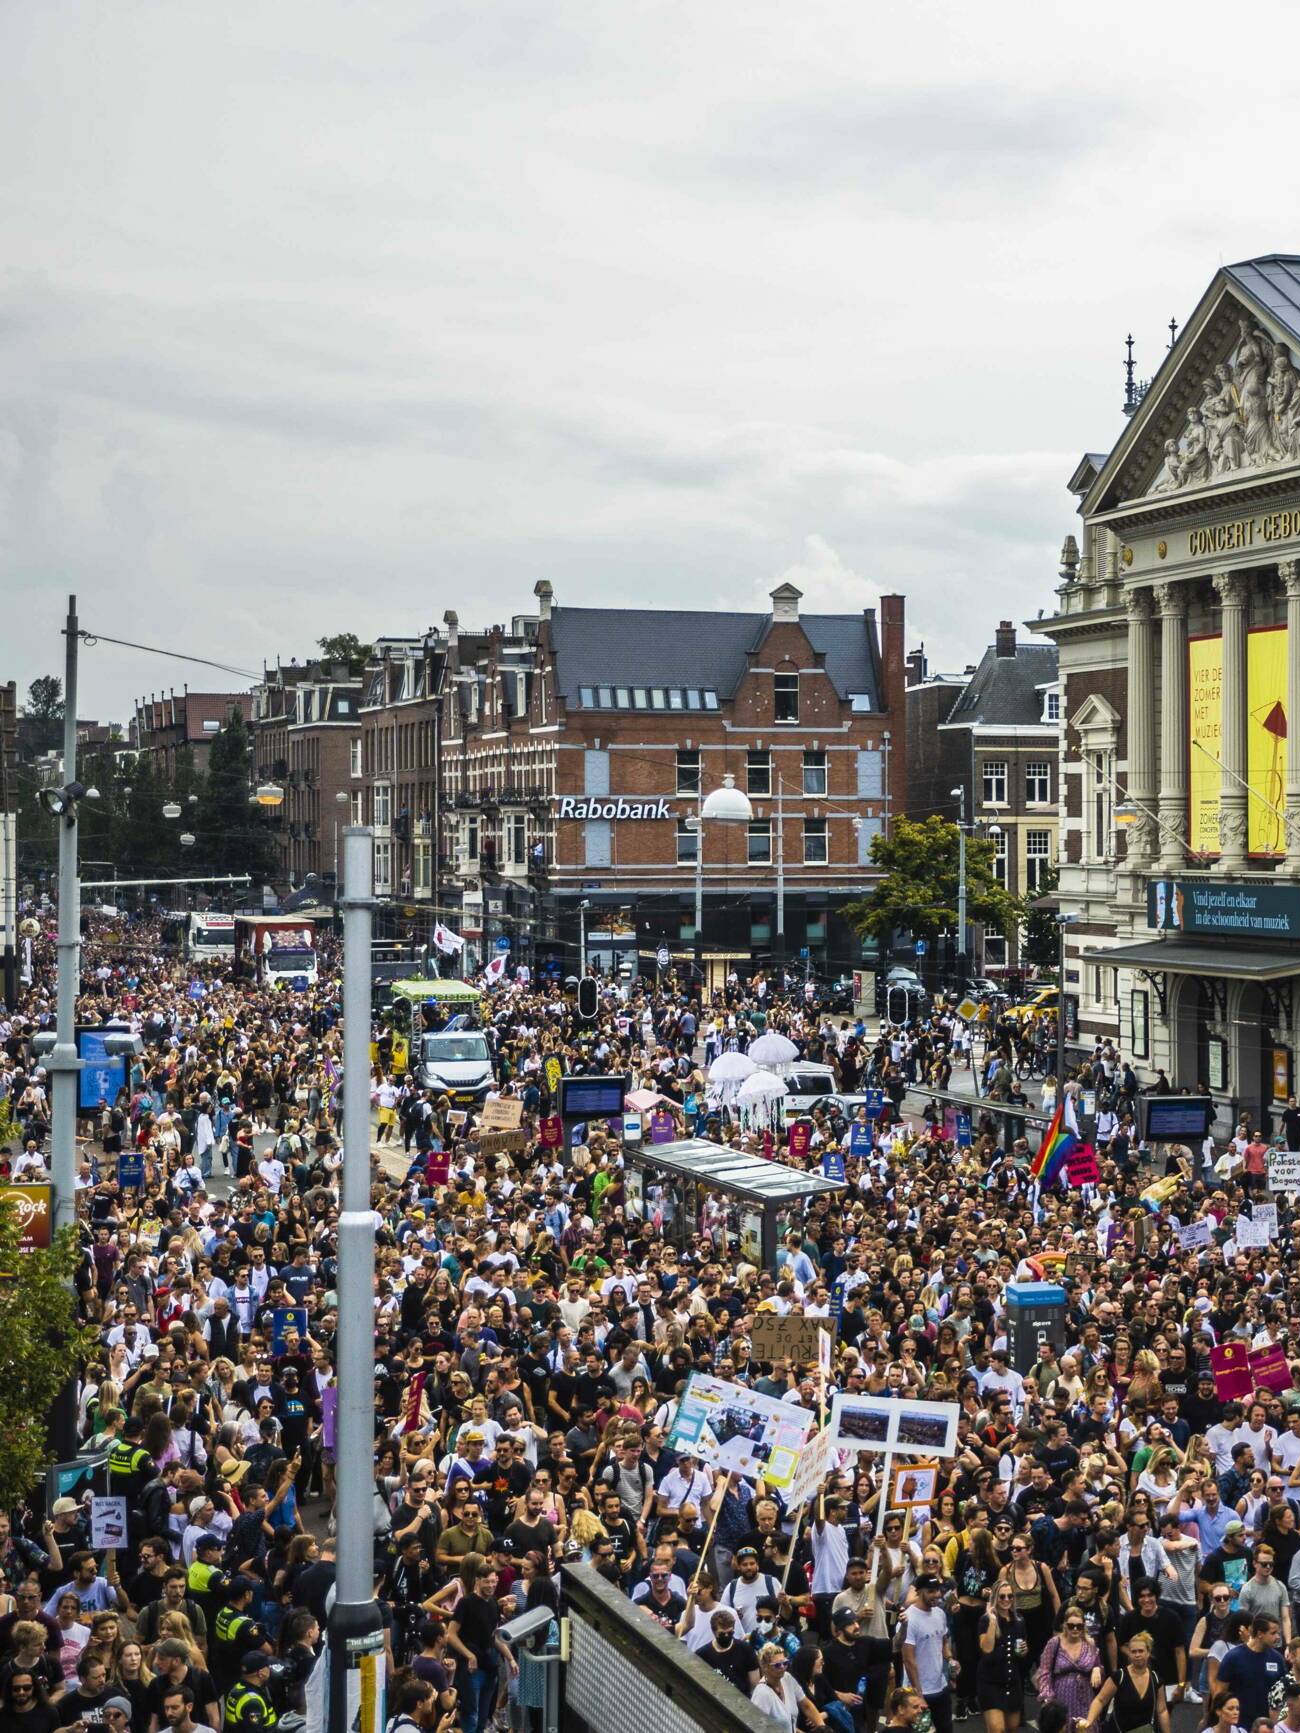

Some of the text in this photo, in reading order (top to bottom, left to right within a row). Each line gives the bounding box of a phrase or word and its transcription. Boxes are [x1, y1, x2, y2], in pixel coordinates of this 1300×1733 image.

[1194, 686, 1221, 702] ZOMER
[1194, 706, 1209, 720] MET
[560, 797, 671, 819] Rabobank
[1193, 891, 1257, 909] Vind jezelf en elkaar
[1195, 910, 1290, 930] in de schoonheid van muziek
[800, 1318, 835, 1332] MAX
[776, 1334, 791, 1343] DE
